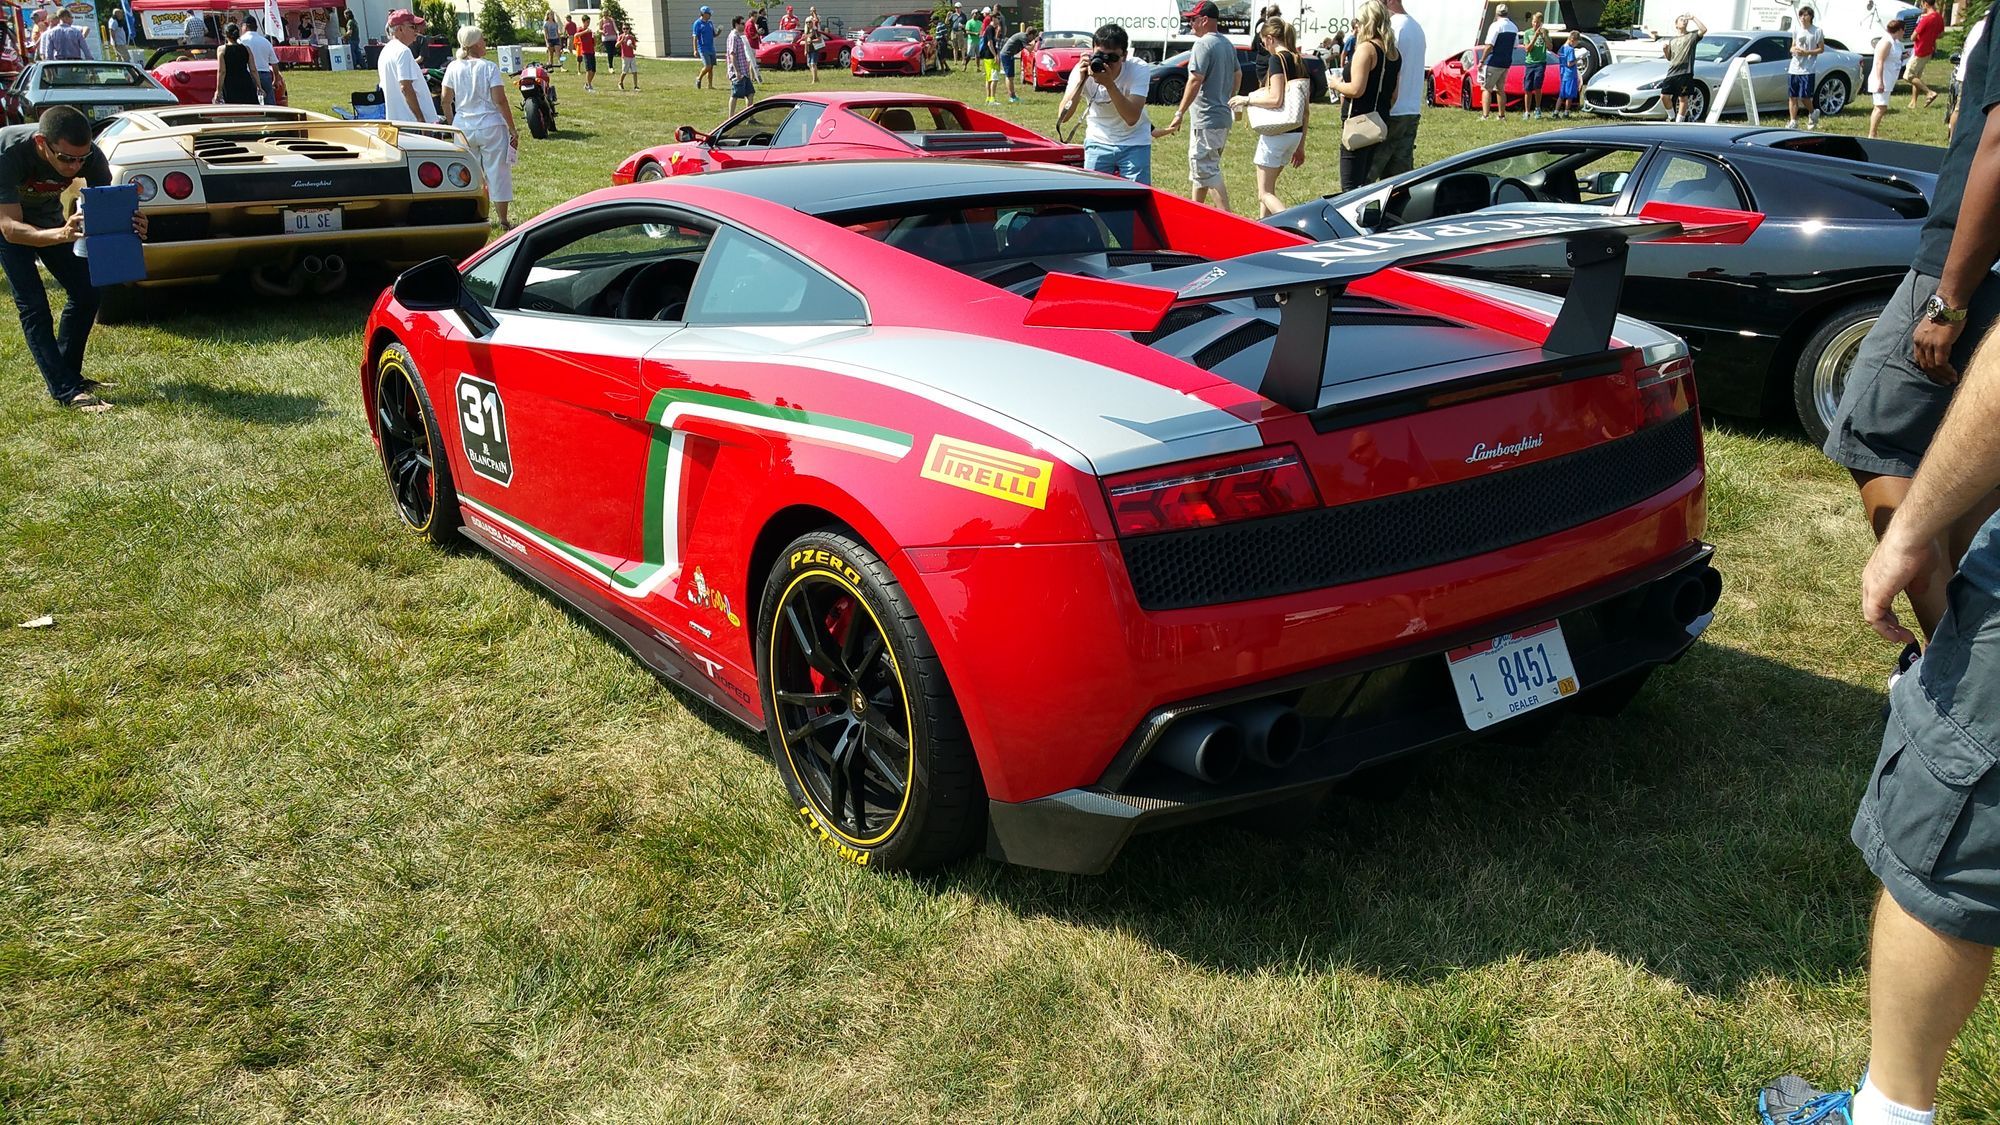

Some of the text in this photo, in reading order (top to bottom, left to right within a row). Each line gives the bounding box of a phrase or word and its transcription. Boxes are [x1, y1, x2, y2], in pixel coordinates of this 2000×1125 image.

[1094, 16, 1180, 29] magcars.co
[1292, 17, 1350, 34] 614-88
[317, 213, 331, 228] SE
[461, 383, 502, 443] 31
[468, 448, 508, 474] BLANCPAIN
[1465, 433, 1543, 463] Lamborghini
[931, 443, 1041, 499] PIRELLI
[791, 549, 861, 585] PZERO
[1469, 673, 1484, 702] 1
[1498, 642, 1558, 697] 8451
[1508, 695, 1539, 713] DEALER
